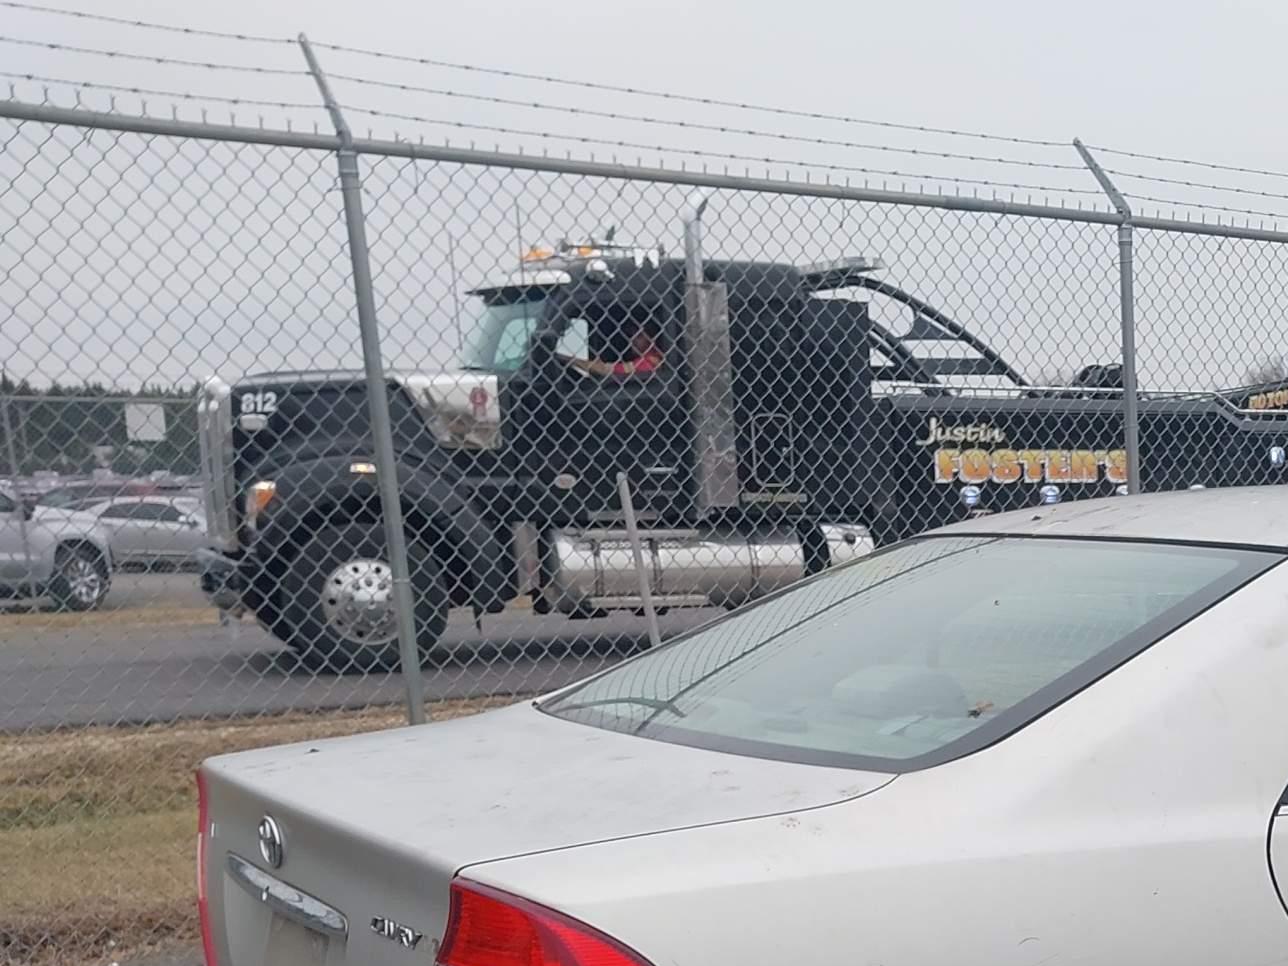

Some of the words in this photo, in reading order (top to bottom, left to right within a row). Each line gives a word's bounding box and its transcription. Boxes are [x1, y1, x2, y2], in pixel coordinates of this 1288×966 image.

[241, 391, 278, 413] 812
[915, 417, 1006, 446] Justin
[934, 448, 1128, 484] FOSTER'S
